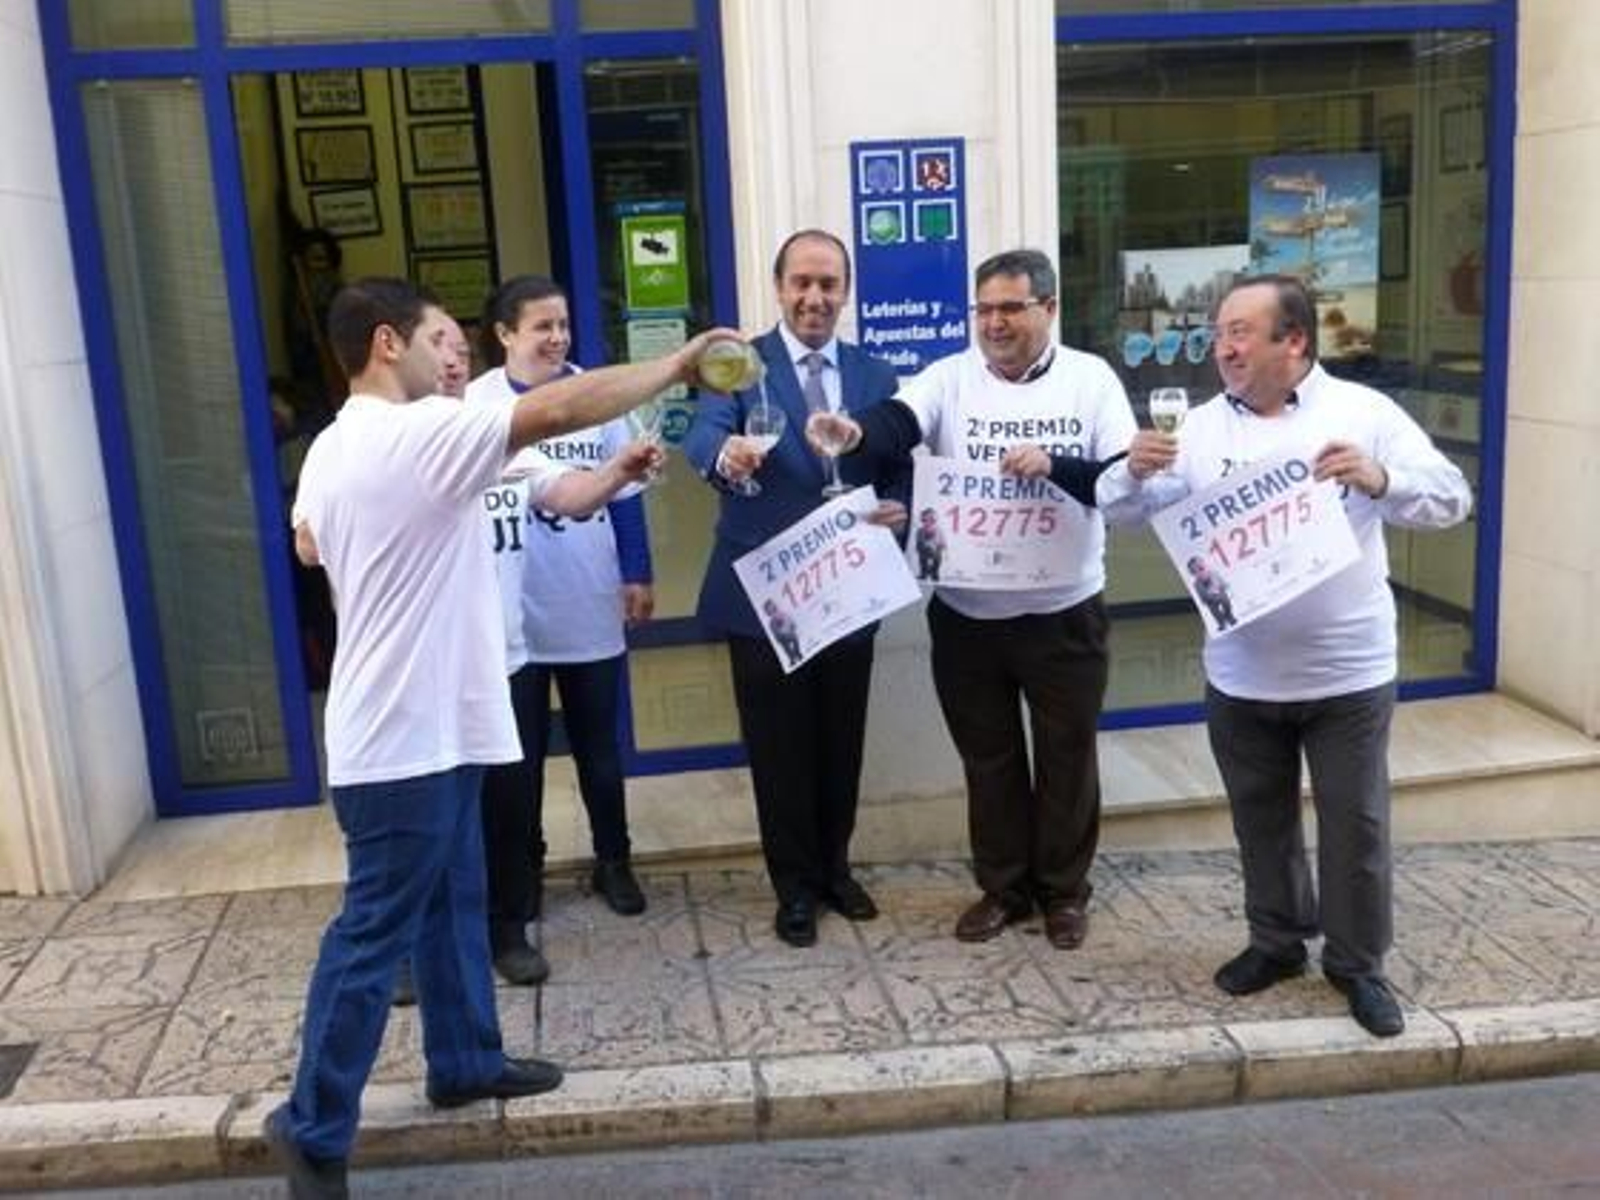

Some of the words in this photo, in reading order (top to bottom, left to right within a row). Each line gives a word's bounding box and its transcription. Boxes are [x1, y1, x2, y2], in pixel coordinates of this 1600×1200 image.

[941, 320, 965, 338] del
[538, 441, 603, 460] REMI
[990, 418, 1083, 438] PREMIO
[1203, 459, 1309, 529] PREMIO
[778, 510, 857, 572] PREMIO
[946, 504, 1058, 538] 12775
[1209, 492, 1311, 568] 12775
[781, 539, 867, 609] 12775
